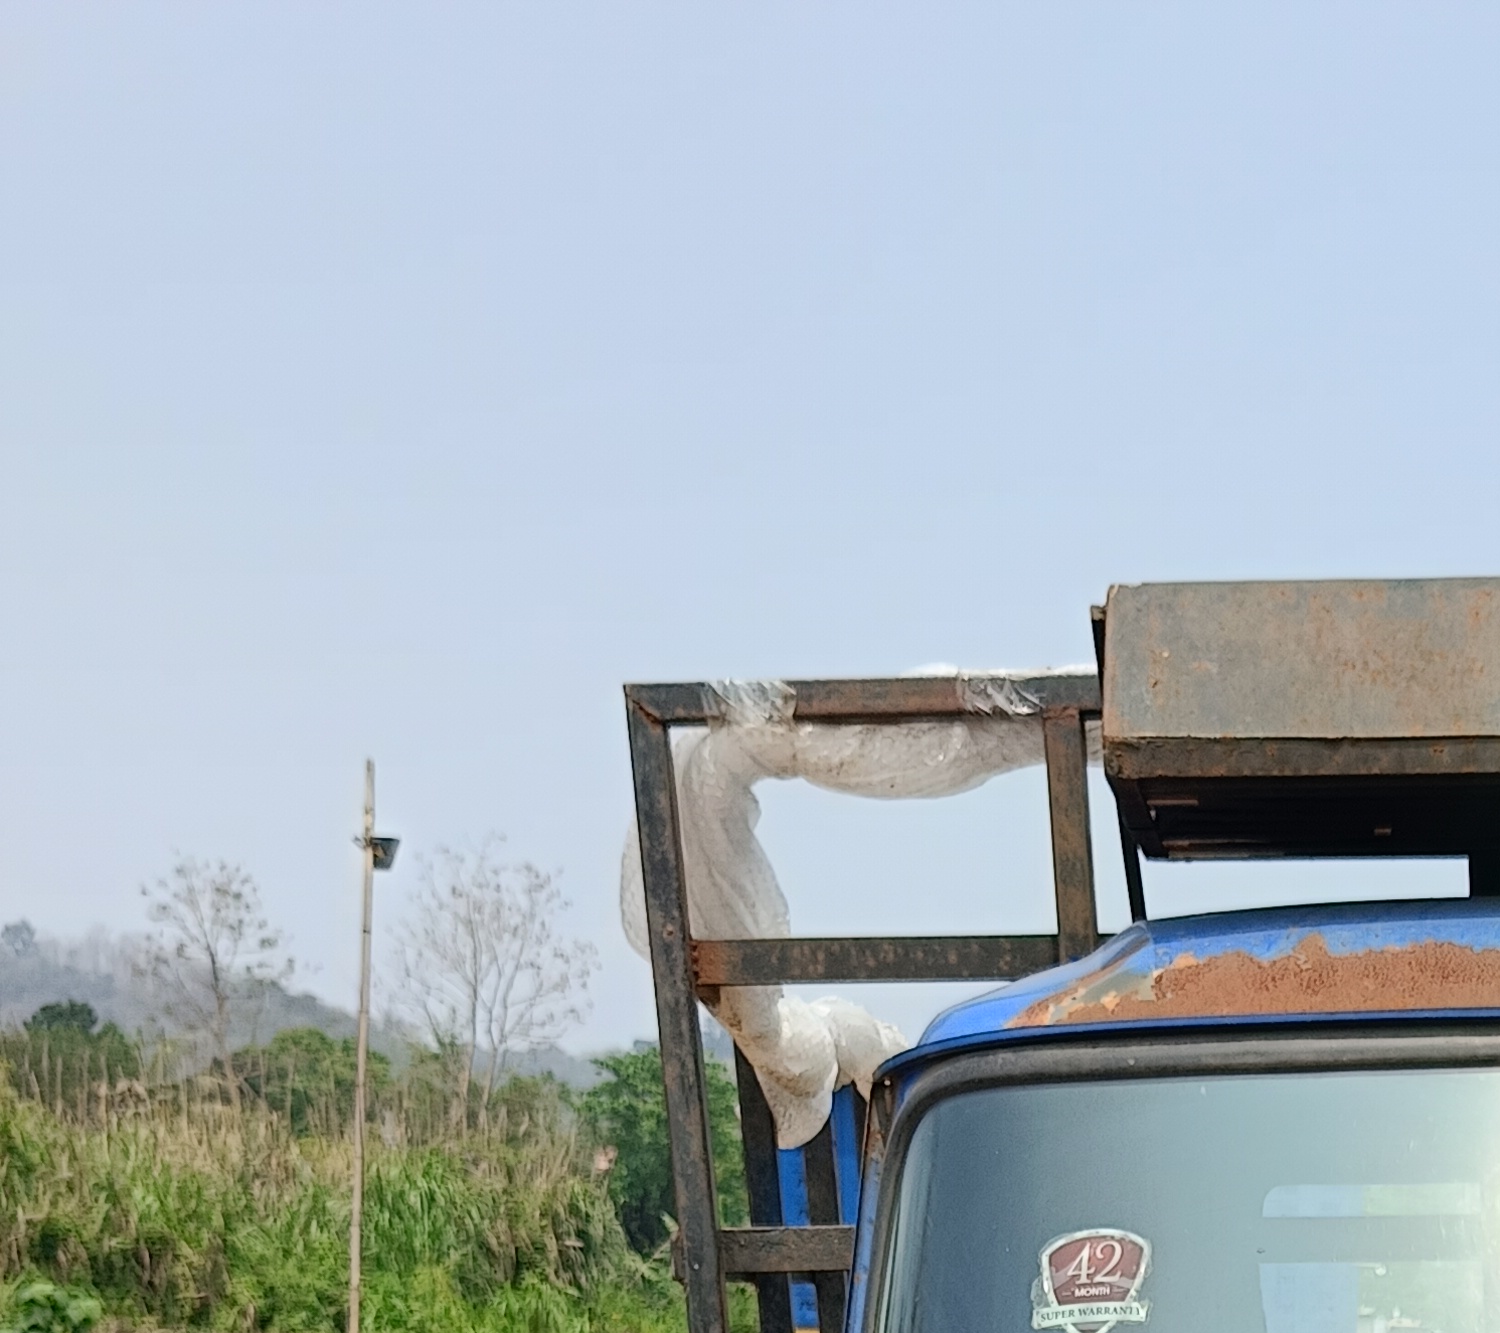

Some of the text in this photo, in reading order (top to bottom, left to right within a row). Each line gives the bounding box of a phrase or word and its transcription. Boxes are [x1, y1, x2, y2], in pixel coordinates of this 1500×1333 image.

[1067, 1241, 1123, 1284] 42
[1075, 1286, 1110, 1297] MONTH
[1040, 1308, 1075, 1322] SUPER
